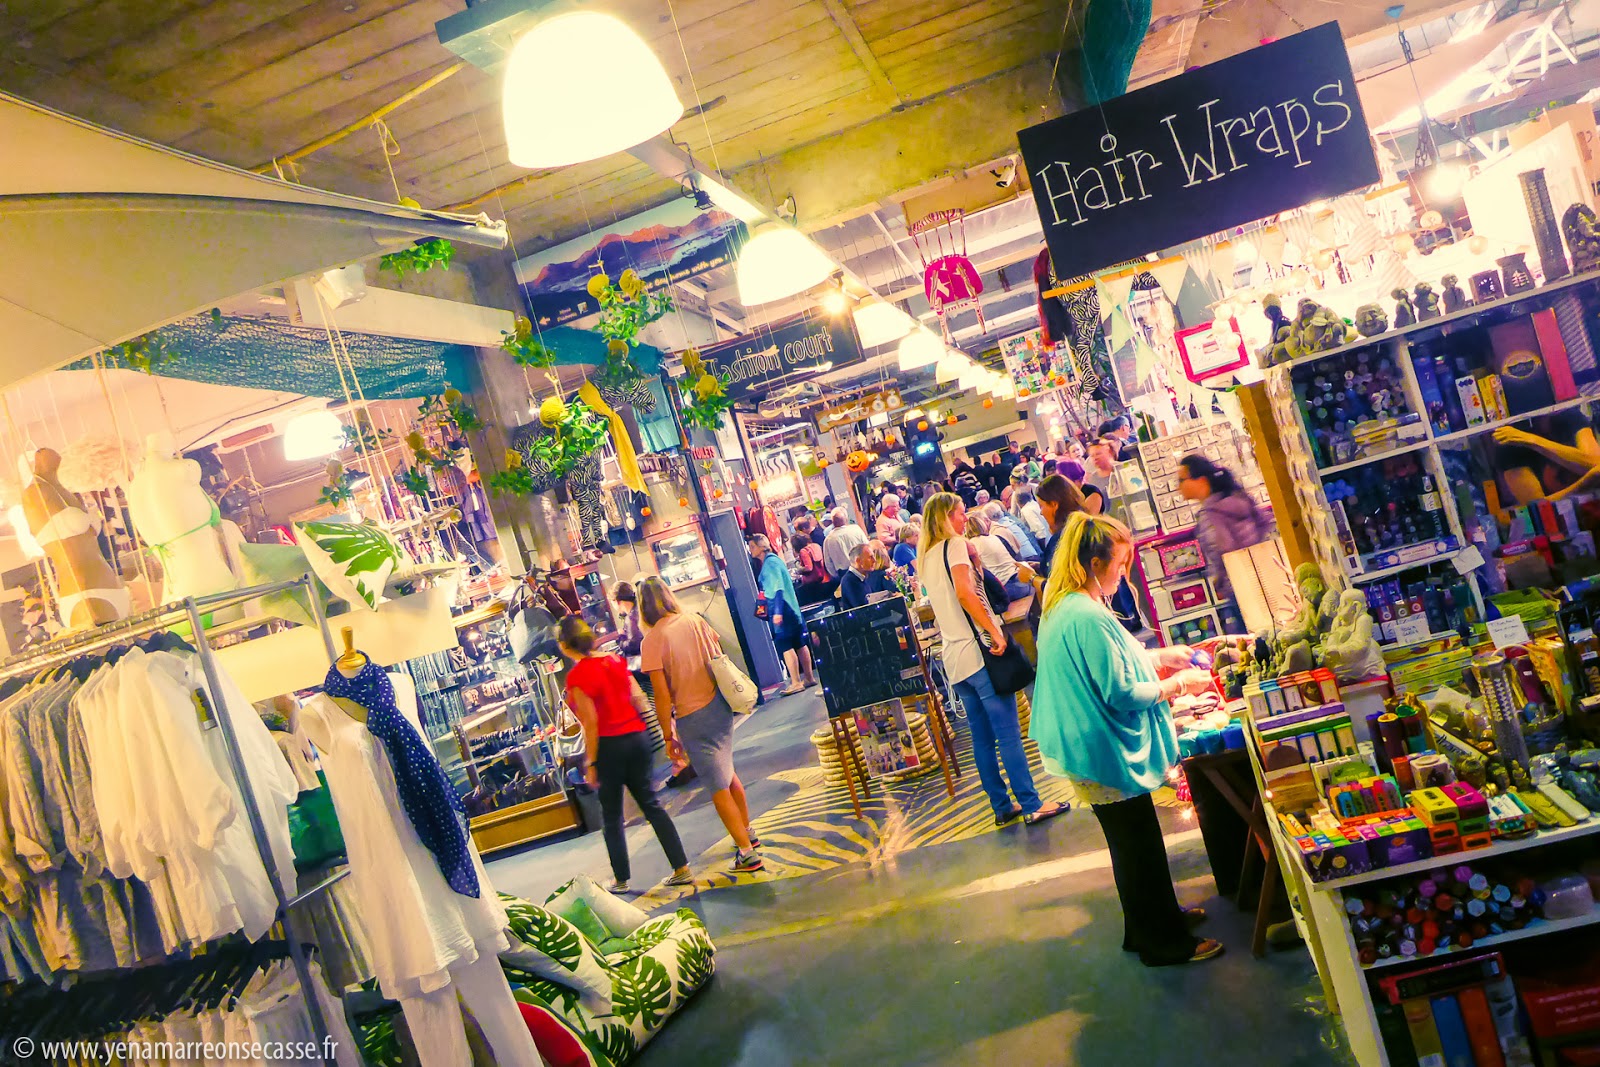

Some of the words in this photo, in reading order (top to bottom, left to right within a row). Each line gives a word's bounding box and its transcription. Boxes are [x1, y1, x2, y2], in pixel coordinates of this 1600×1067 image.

[1036, 133, 1162, 228] Hair
[1160, 78, 1353, 190] Wraps
[691, 261, 710, 275] with
[709, 256, 724, 270] you
[710, 347, 781, 385] Fashion
[783, 326, 833, 365] court
[825, 626, 893, 664] Hair
